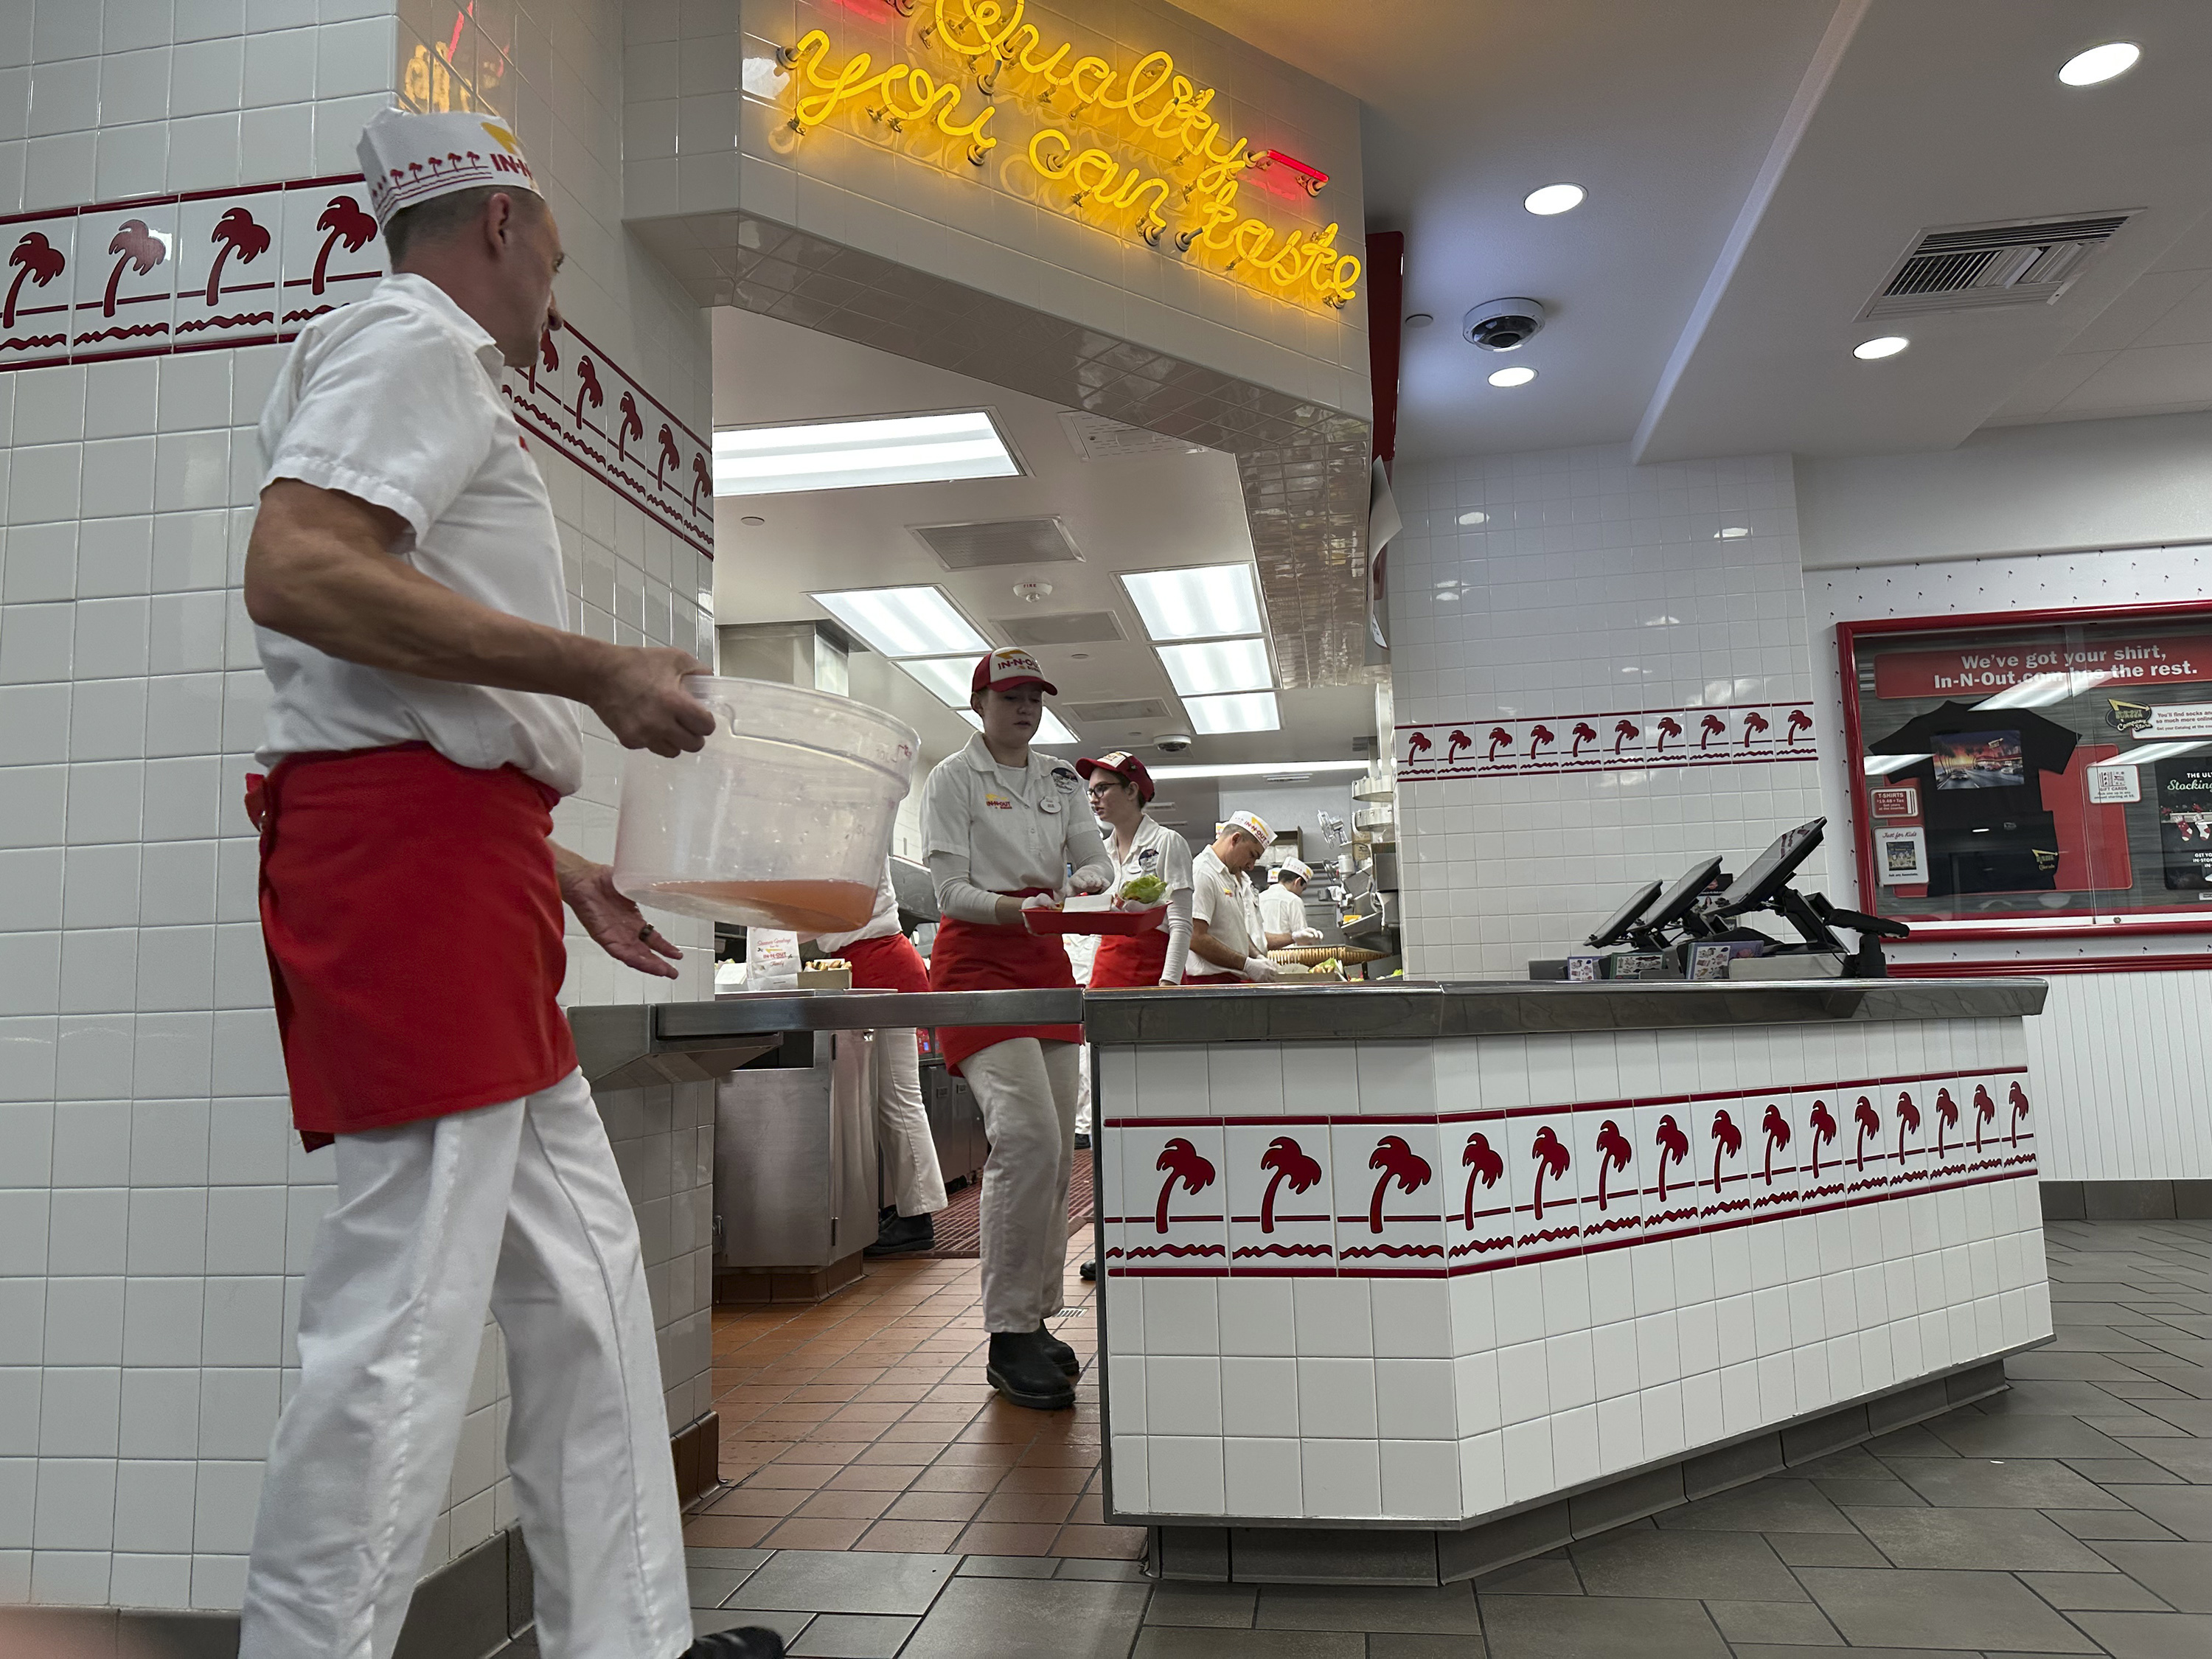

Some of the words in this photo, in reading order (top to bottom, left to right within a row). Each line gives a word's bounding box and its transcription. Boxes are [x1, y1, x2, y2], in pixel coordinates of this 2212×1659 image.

[934, 0, 1248, 193] Quality
[796, 29, 997, 145] you
[1029, 128, 1170, 229] can
[1202, 181, 1361, 299] taste
[1961, 653, 2019, 669] We've
[2025, 650, 2057, 669] got
[2064, 649, 2107, 667] your
[2113, 644, 2166, 661] shirt,
[2110, 664, 2148, 678] the
[2150, 660, 2198, 676] rest.
[1244, 821, 1267, 841] IN-N-OUT
